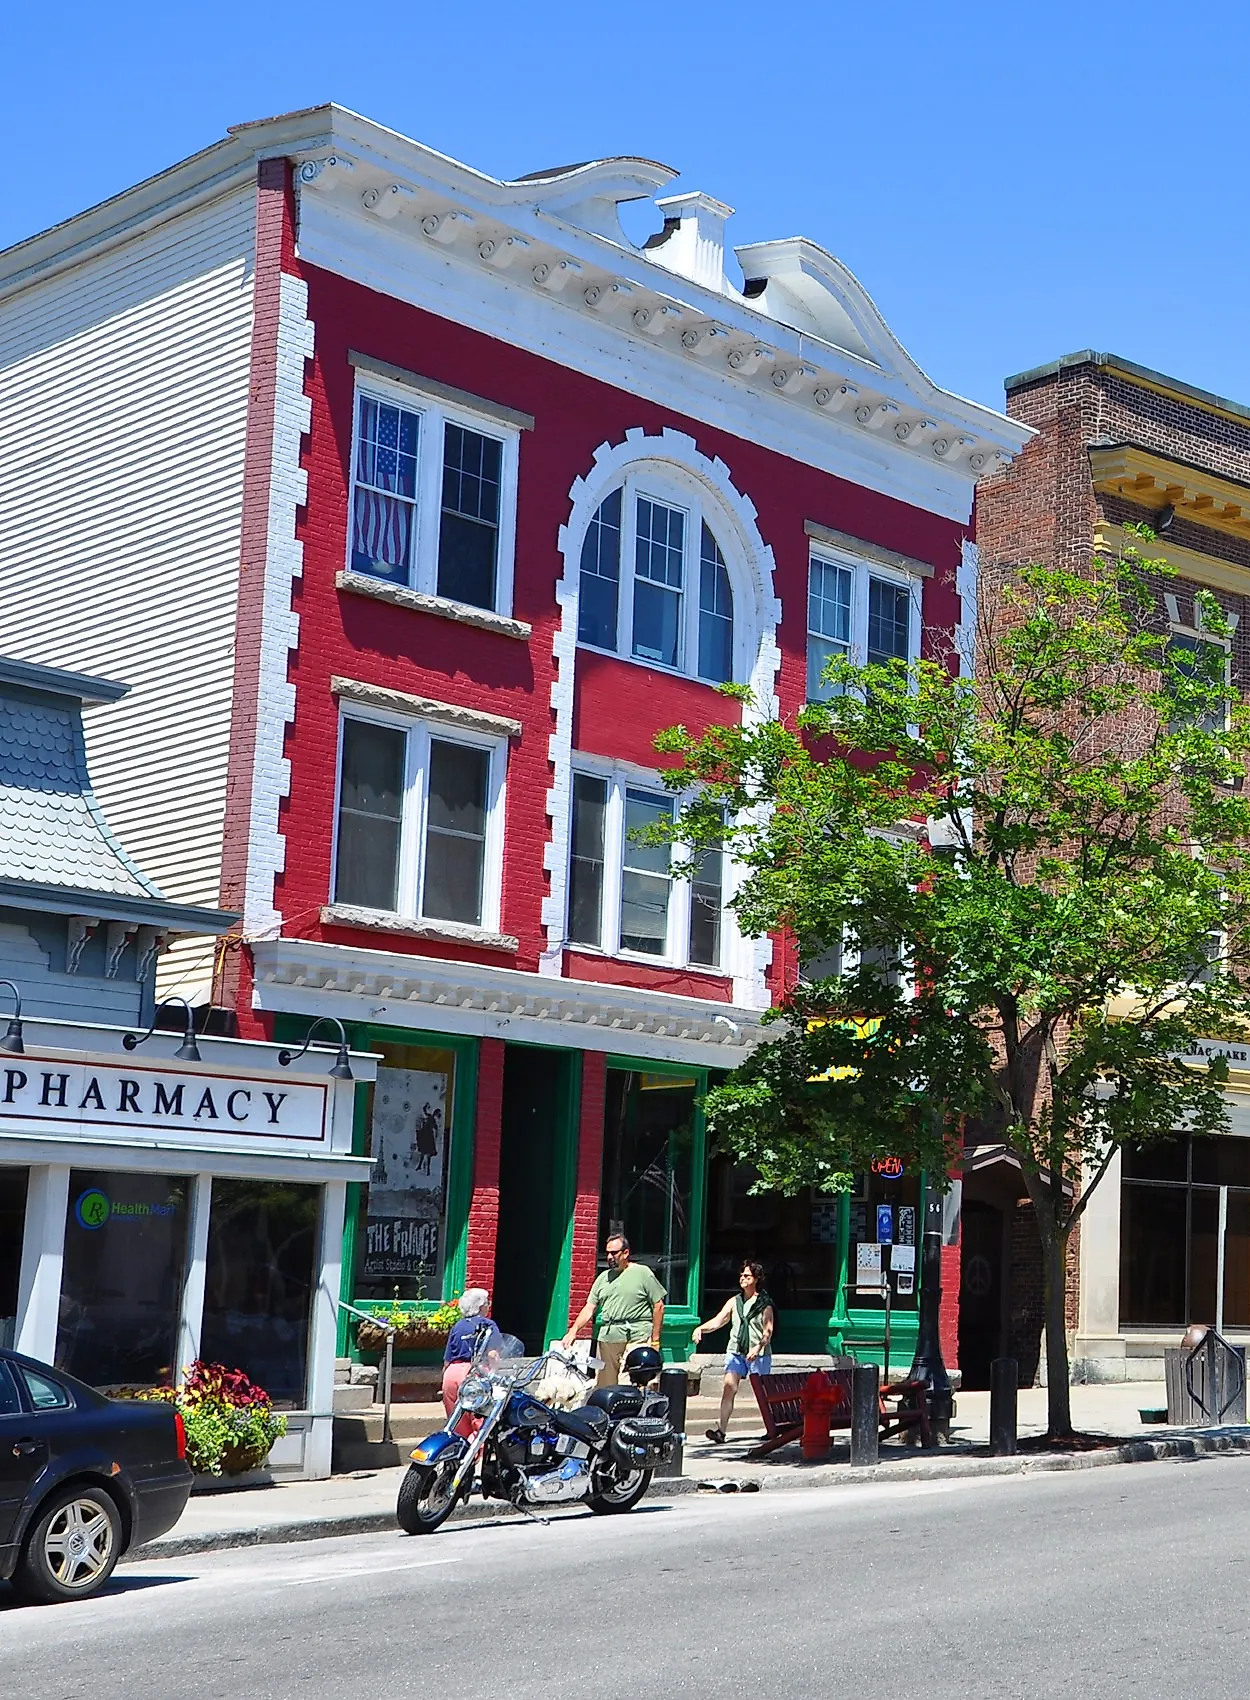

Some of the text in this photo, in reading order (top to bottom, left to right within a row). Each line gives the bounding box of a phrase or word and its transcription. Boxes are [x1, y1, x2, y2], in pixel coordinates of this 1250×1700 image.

[3, 1069, 289, 1124] PHARMACY
[871, 1157, 901, 1174] OPEN
[367, 1223, 390, 1254] THE
